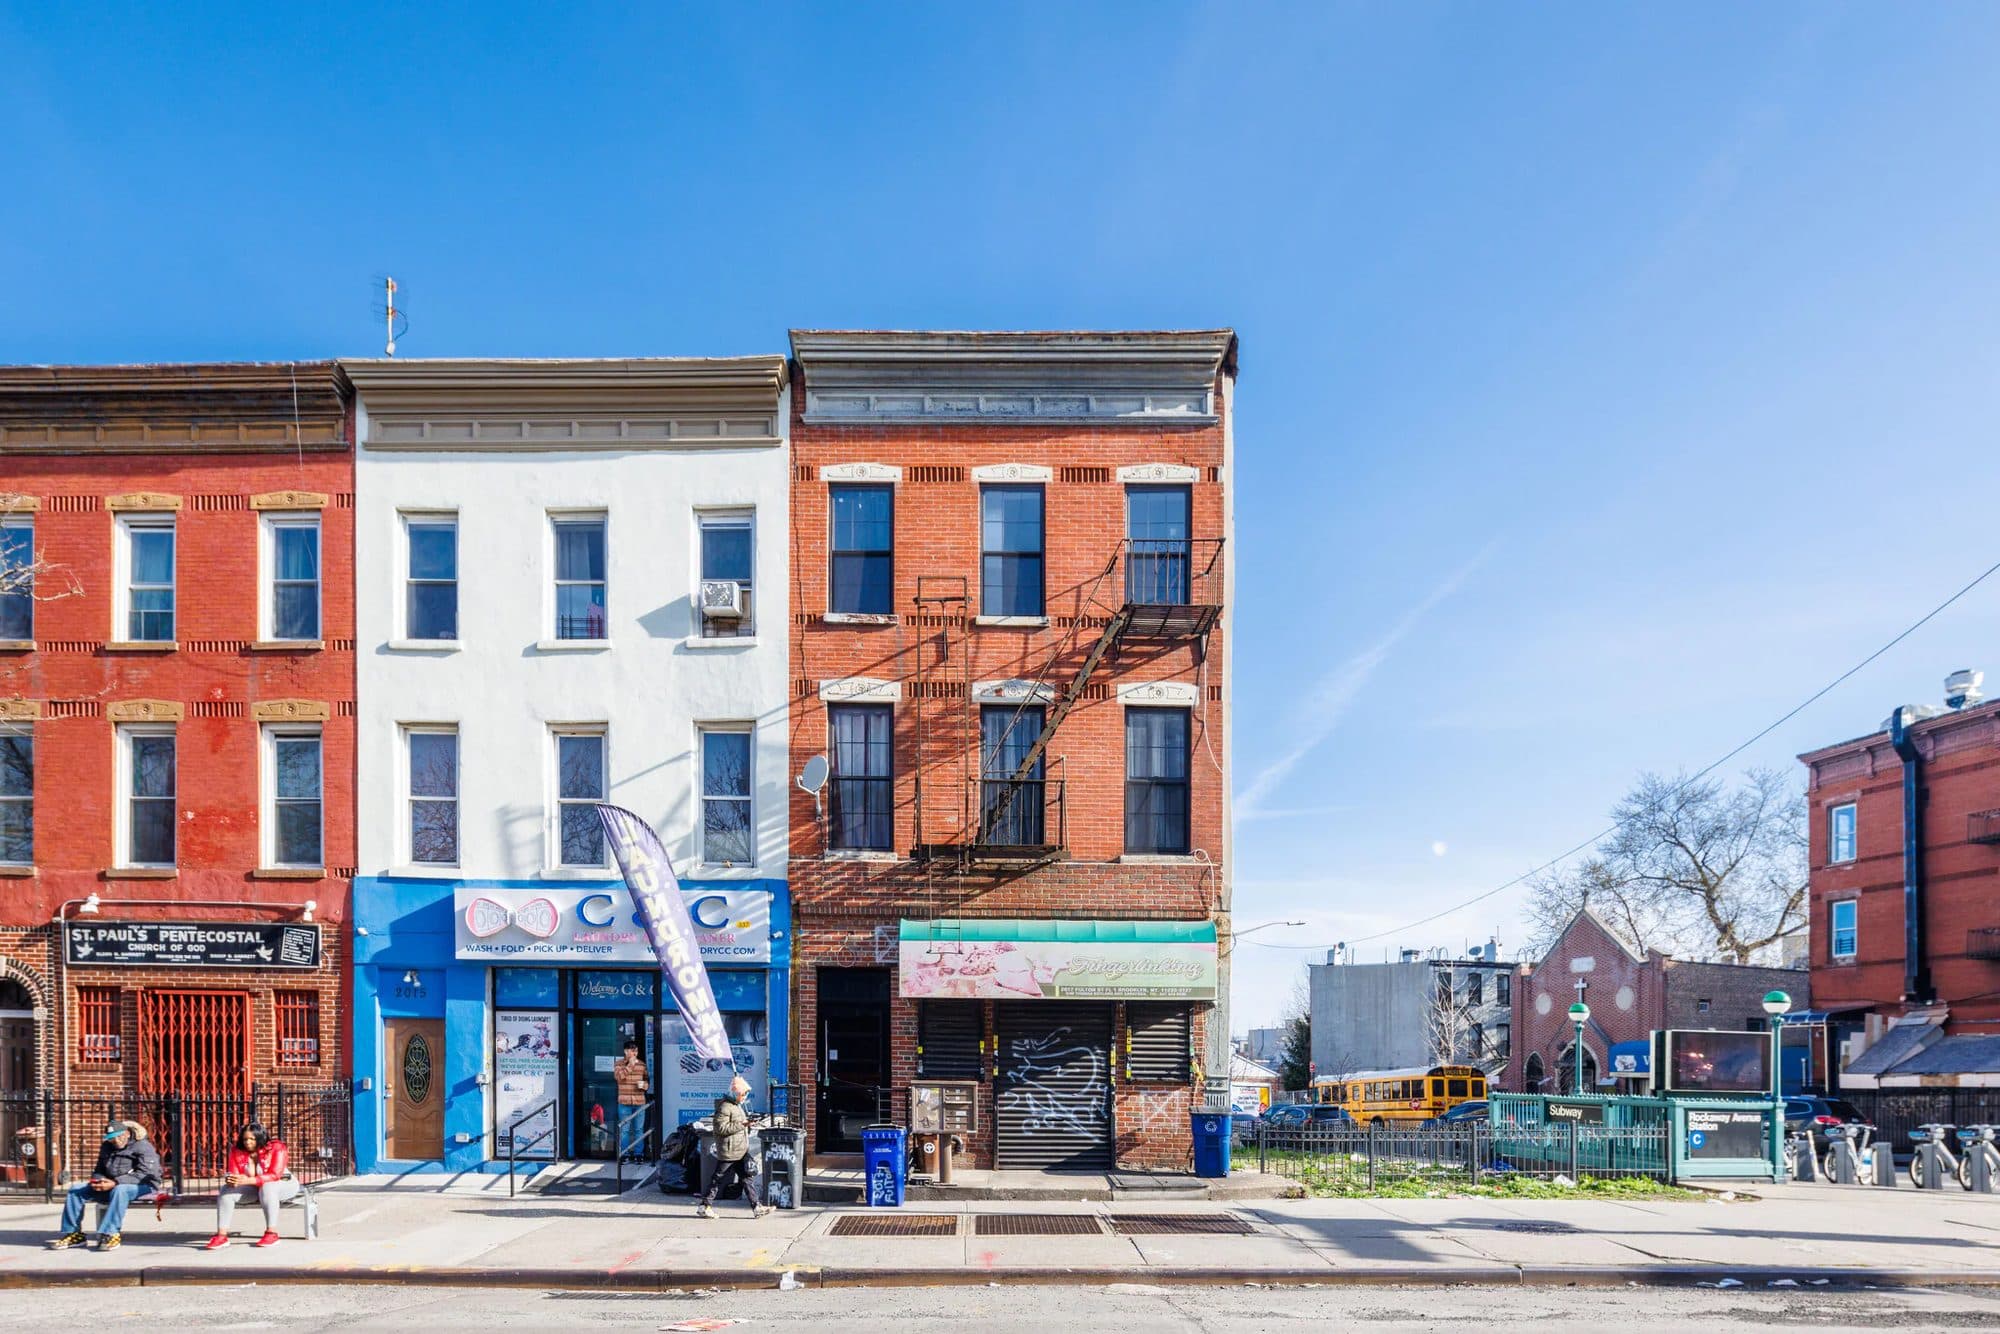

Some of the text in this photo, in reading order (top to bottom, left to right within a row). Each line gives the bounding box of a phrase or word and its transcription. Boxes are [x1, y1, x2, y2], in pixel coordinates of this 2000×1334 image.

[576, 895, 615, 928] C
[691, 896, 729, 929] C
[72, 929, 265, 943] ST. PAUL'S PENTECOSTAL
[127, 943, 206, 952] CHURCH OF GOD
[466, 945, 493, 953] WASH
[501, 945, 525, 953] FOLD
[533, 945, 552, 953] PICK
[556, 945, 568, 953] UP
[576, 945, 613, 954] DELIVER
[621, 983, 633, 995] C
[1549, 1104, 1582, 1119] Subway
[1688, 1111, 1761, 1124] Rockaway Avenue
[1688, 1121, 1718, 1131] Station
[1692, 1134, 1702, 1145] C
